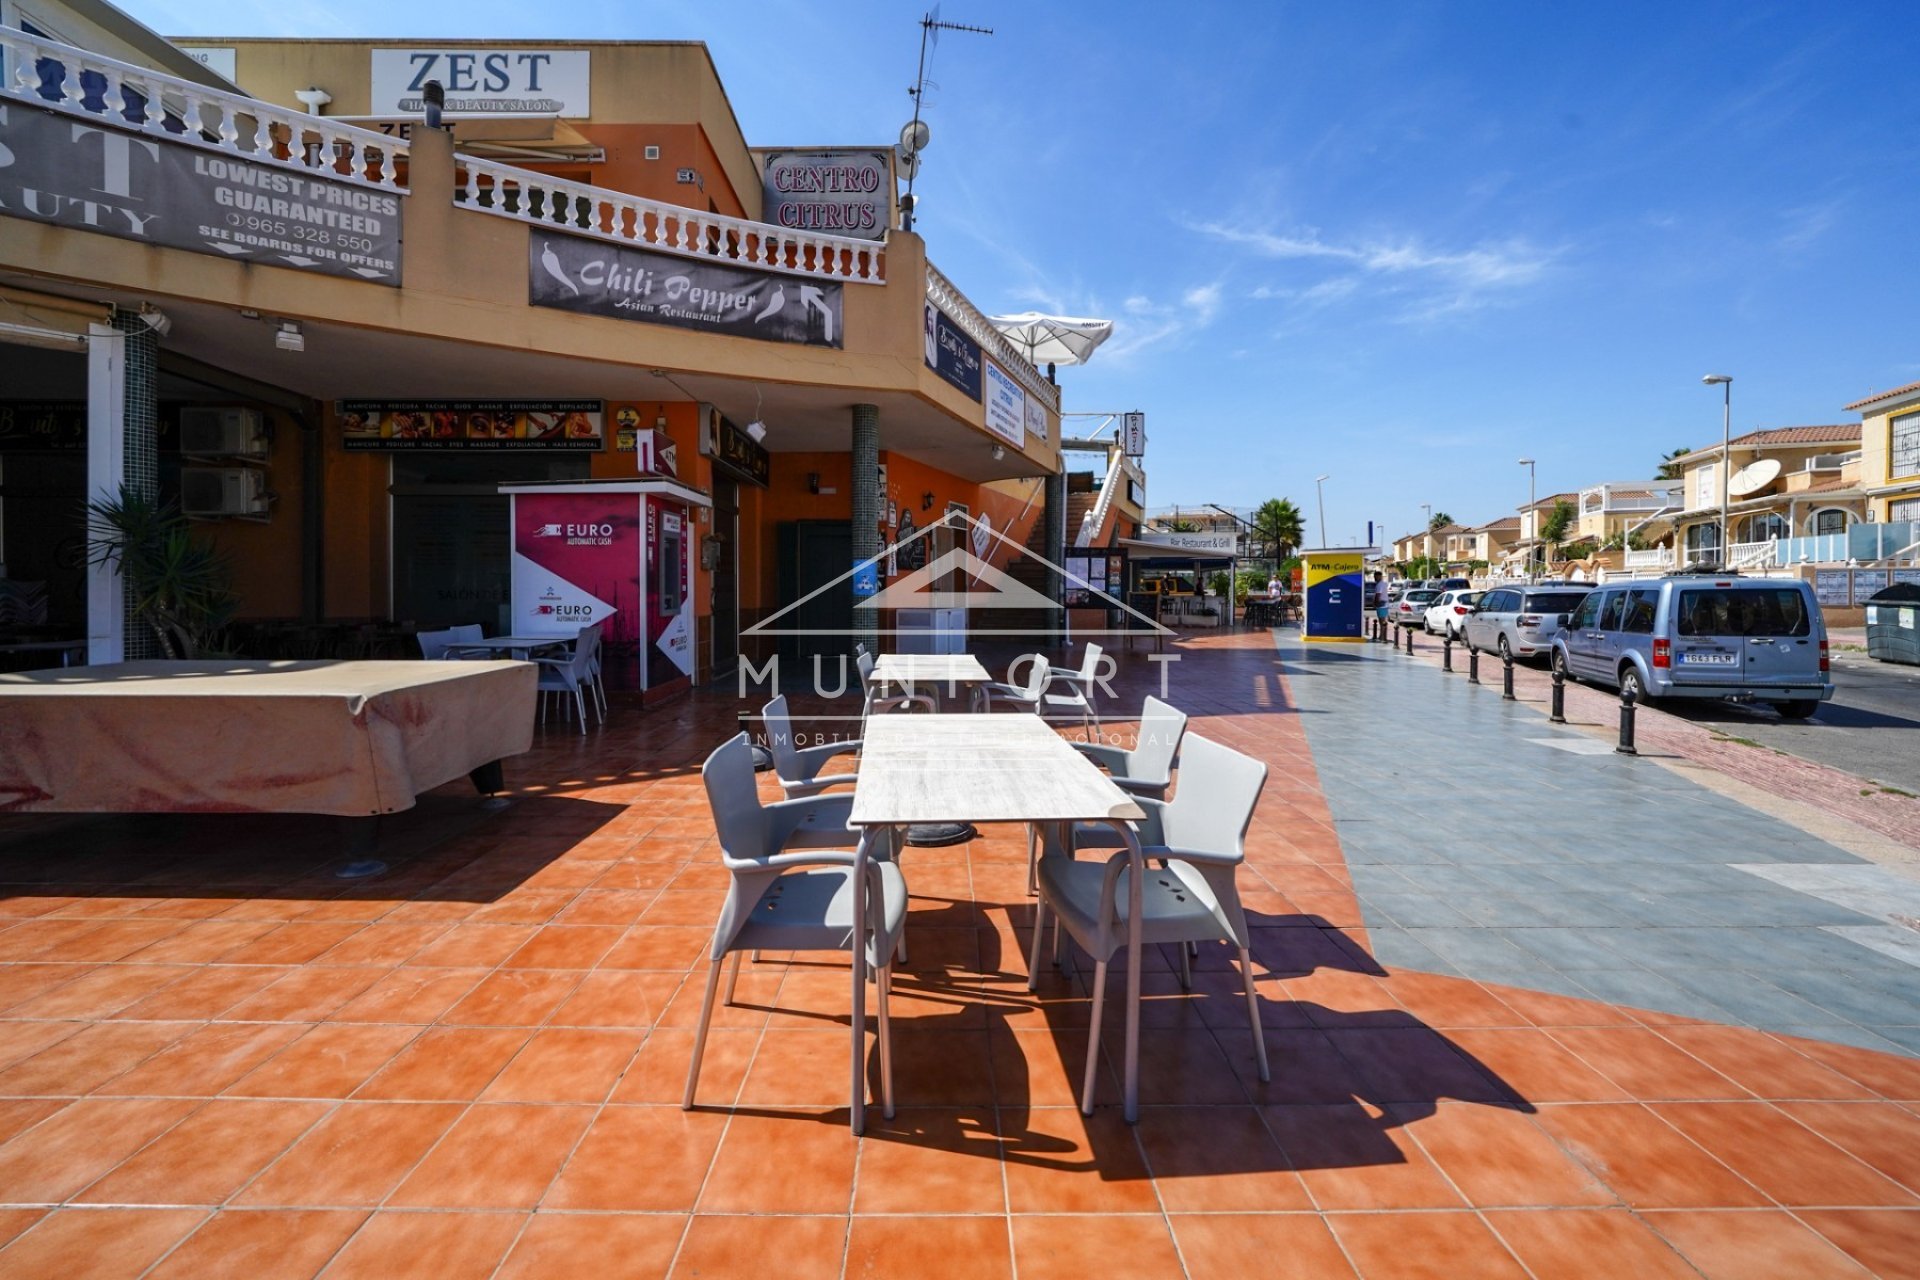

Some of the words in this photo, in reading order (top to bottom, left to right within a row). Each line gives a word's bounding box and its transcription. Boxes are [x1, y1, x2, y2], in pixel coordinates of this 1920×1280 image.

[406, 53, 550, 92] ZEST
[445, 102, 455, 110] &
[456, 102, 504, 110] BEAUTY
[510, 102, 552, 110] SALON
[195, 155, 304, 196] LOWEST
[310, 183, 397, 216] PRICES
[774, 165, 879, 192] CENTRO
[215, 186, 381, 236] GUARANTEED
[778, 202, 876, 229] CITRUS
[198, 225, 230, 240] SEE
[234, 231, 303, 254] BOARDS
[307, 245, 337, 260] FOR
[340, 252, 394, 270] OFFERS
[247, 216, 286, 235] 965
[293, 225, 330, 244] 328
[337, 234, 372, 252] 550
[580, 260, 653, 295] Chili
[664, 275, 758, 312] Pepper
[614, 297, 654, 313] Asian
[659, 303, 722, 323] Restaurant
[566, 523, 613, 537] EURO
[567, 537, 597, 546] AUTOMATIC
[598, 537, 612, 546] CASH
[1182, 538, 1212, 548] Restaurant
[1212, 538, 1218, 548] &
[1218, 538, 1231, 548] Grill
[1333, 563, 1359, 571] Cajero
[556, 605, 592, 615] EURO
